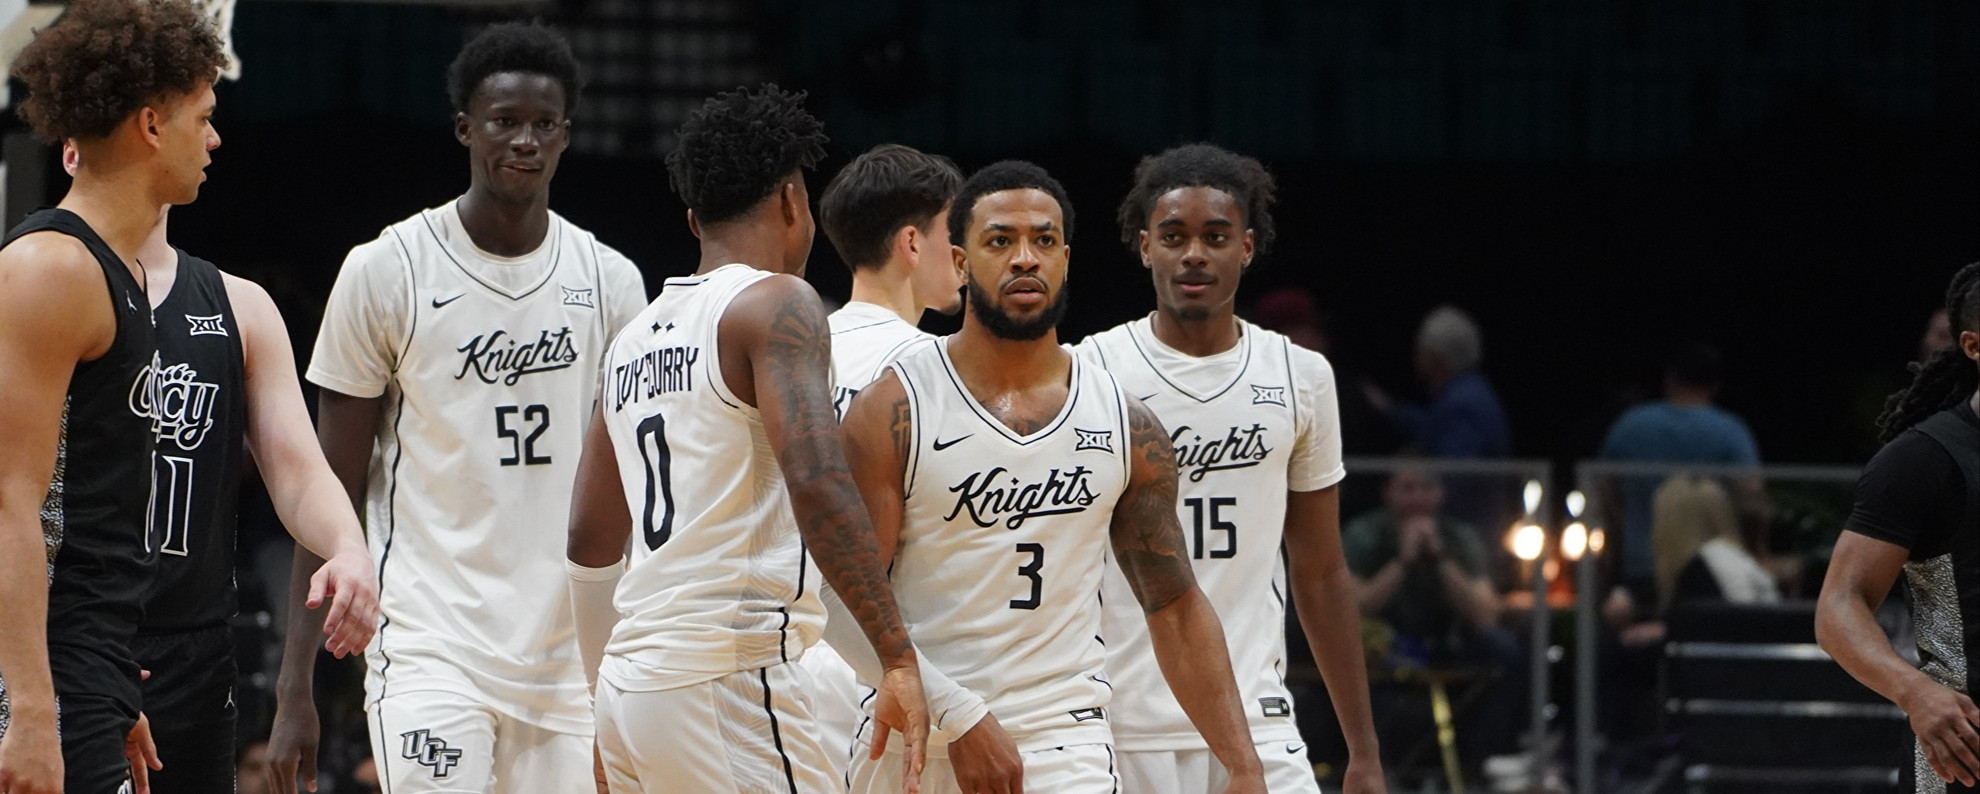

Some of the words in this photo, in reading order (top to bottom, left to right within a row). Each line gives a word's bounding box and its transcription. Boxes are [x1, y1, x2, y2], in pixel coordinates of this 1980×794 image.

[187, 314, 229, 337] XII
[561, 285, 595, 309] XII
[454, 326, 579, 387] Knights
[615, 346, 699, 413] IVY-CURRY
[1250, 384, 1287, 408] XII
[495, 404, 552, 467] 52
[1074, 427, 1114, 455] XII
[636, 413, 675, 552] 0
[943, 466, 1101, 531] Knights
[1184, 497, 1237, 560] 15
[1009, 543, 1045, 610] 3
[400, 728, 463, 778] UCF
